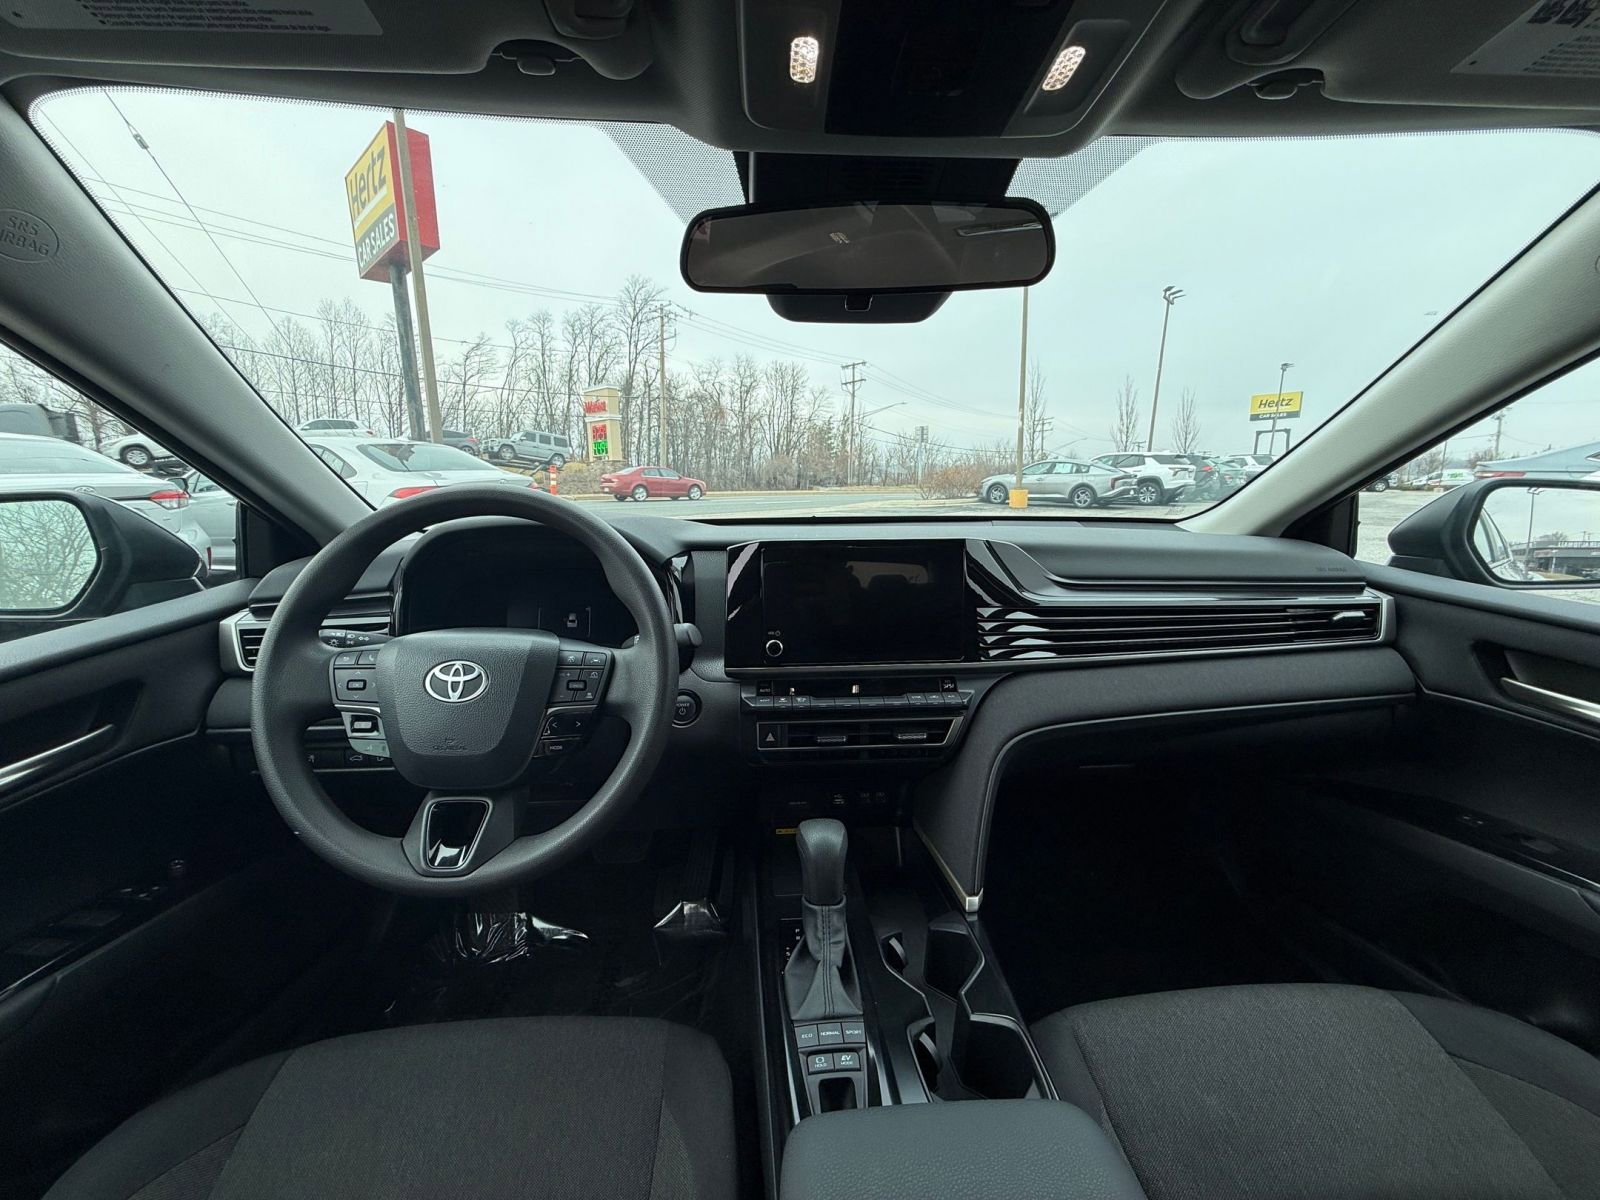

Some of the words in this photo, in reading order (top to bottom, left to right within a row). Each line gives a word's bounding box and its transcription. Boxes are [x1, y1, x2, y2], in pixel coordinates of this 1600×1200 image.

[350, 145, 387, 222] Hertz
[0, 229, 49, 256] IRBAG
[7, 215, 40, 236] SRS
[357, 239, 371, 267] CAR
[370, 214, 395, 255] SALES
